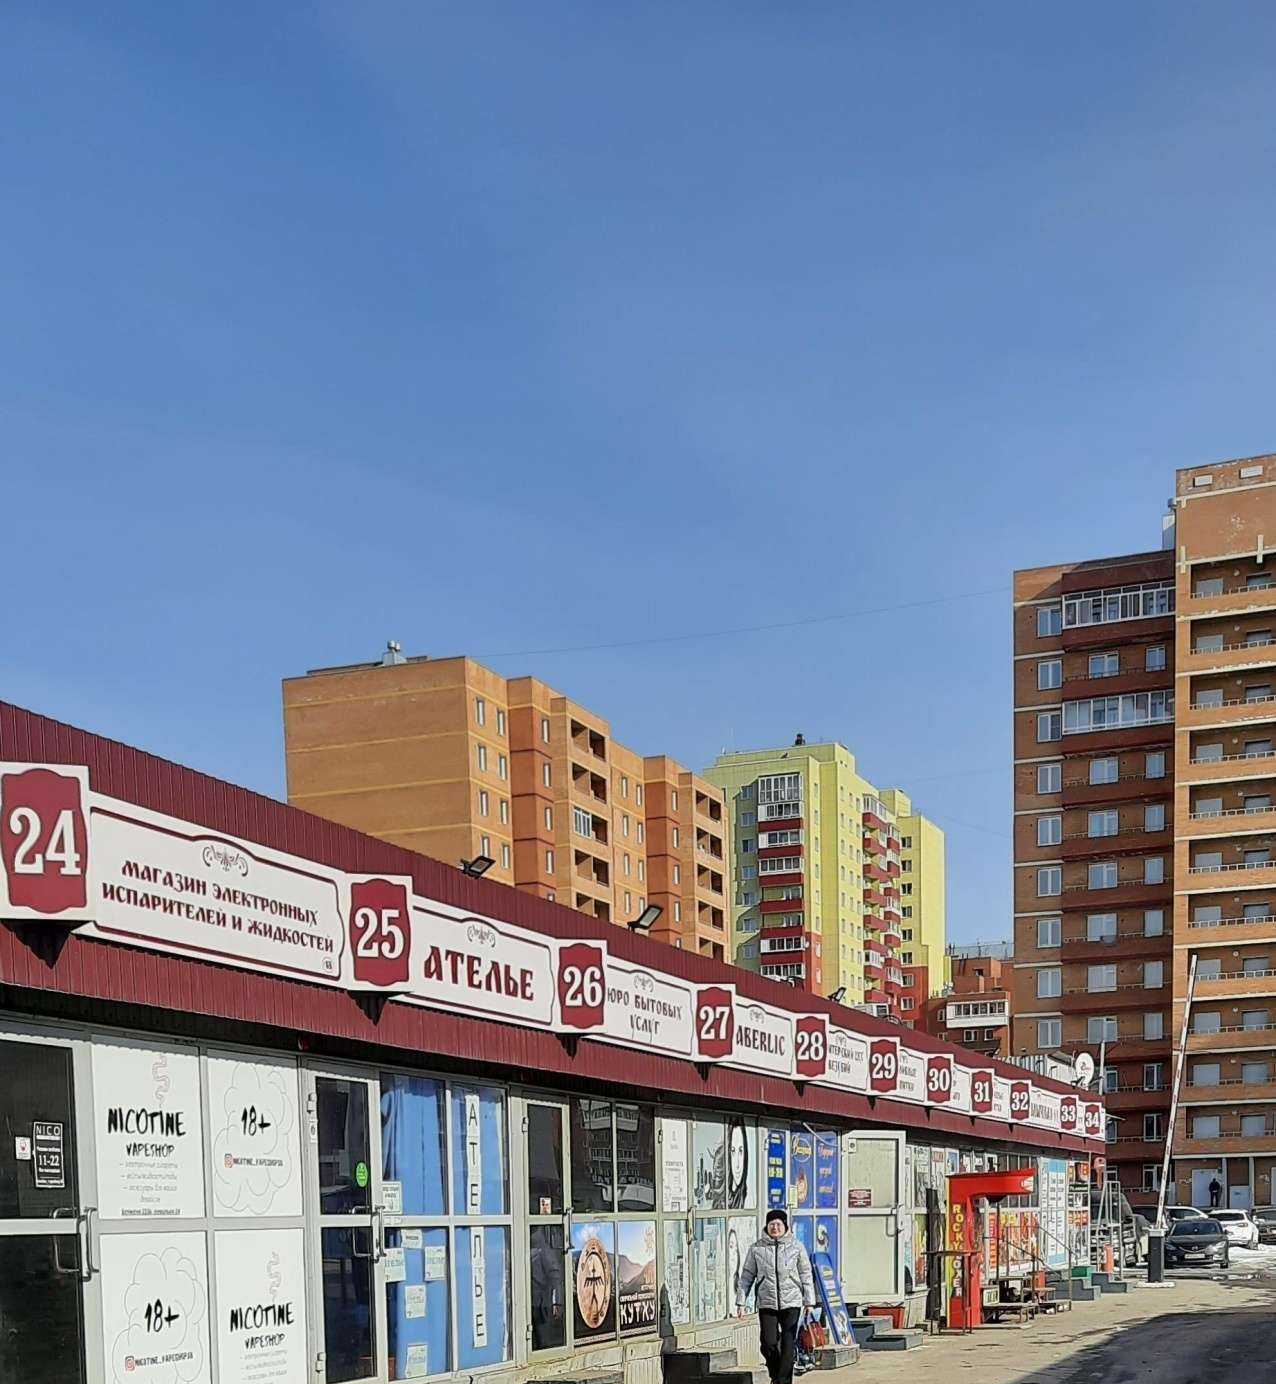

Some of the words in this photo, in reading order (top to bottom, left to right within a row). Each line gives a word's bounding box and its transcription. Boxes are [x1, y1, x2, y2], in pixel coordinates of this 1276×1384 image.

[10, 807, 81, 876] 24
[121, 860, 207, 898] МАГАЗИН
[212, 883, 319, 928] ЭЛЕКТРОННЫХ
[102, 882, 227, 929] ИСПАРИТЕЛЕЙ
[232, 914, 242, 931] И
[247, 919, 334, 953] ЖИДКОСТЕЙ
[355, 907, 404, 960] 25
[424, 946, 534, 1001] АТЕЛЬЕ
[563, 966, 602, 1007] 26
[607, 988, 630, 1007] ЮРО
[634, 995, 683, 1021] БЫТОВЫХ
[630, 1014, 661, 1042] УСЛУГ
[700, 1006, 730, 1040] 27
[736, 1025, 786, 1056] ABERLIC
[796, 1031, 824, 1061] 28
[872, 1053, 896, 1079] 29
[928, 1068, 951, 1091] 30
[974, 1081, 990, 1102] 31
[1011, 1091, 1029, 1111] 32
[108, 1107, 187, 1137] NICOTINE
[241, 1105, 271, 1136] 18+
[1061, 1105, 1076, 1122] 33
[1085, 1112, 1099, 1127] 34
[36, 1125, 61, 1136] NICO
[39, 1154, 60, 1167] 11-22
[126, 1142, 175, 1158] VAPESHOP
[144, 1298, 180, 1332] 18+
[230, 1302, 294, 1332] NICOTINE
[620, 1300, 656, 1325] КУТХУ
[245, 1333, 285, 1349] VAPESHOP
